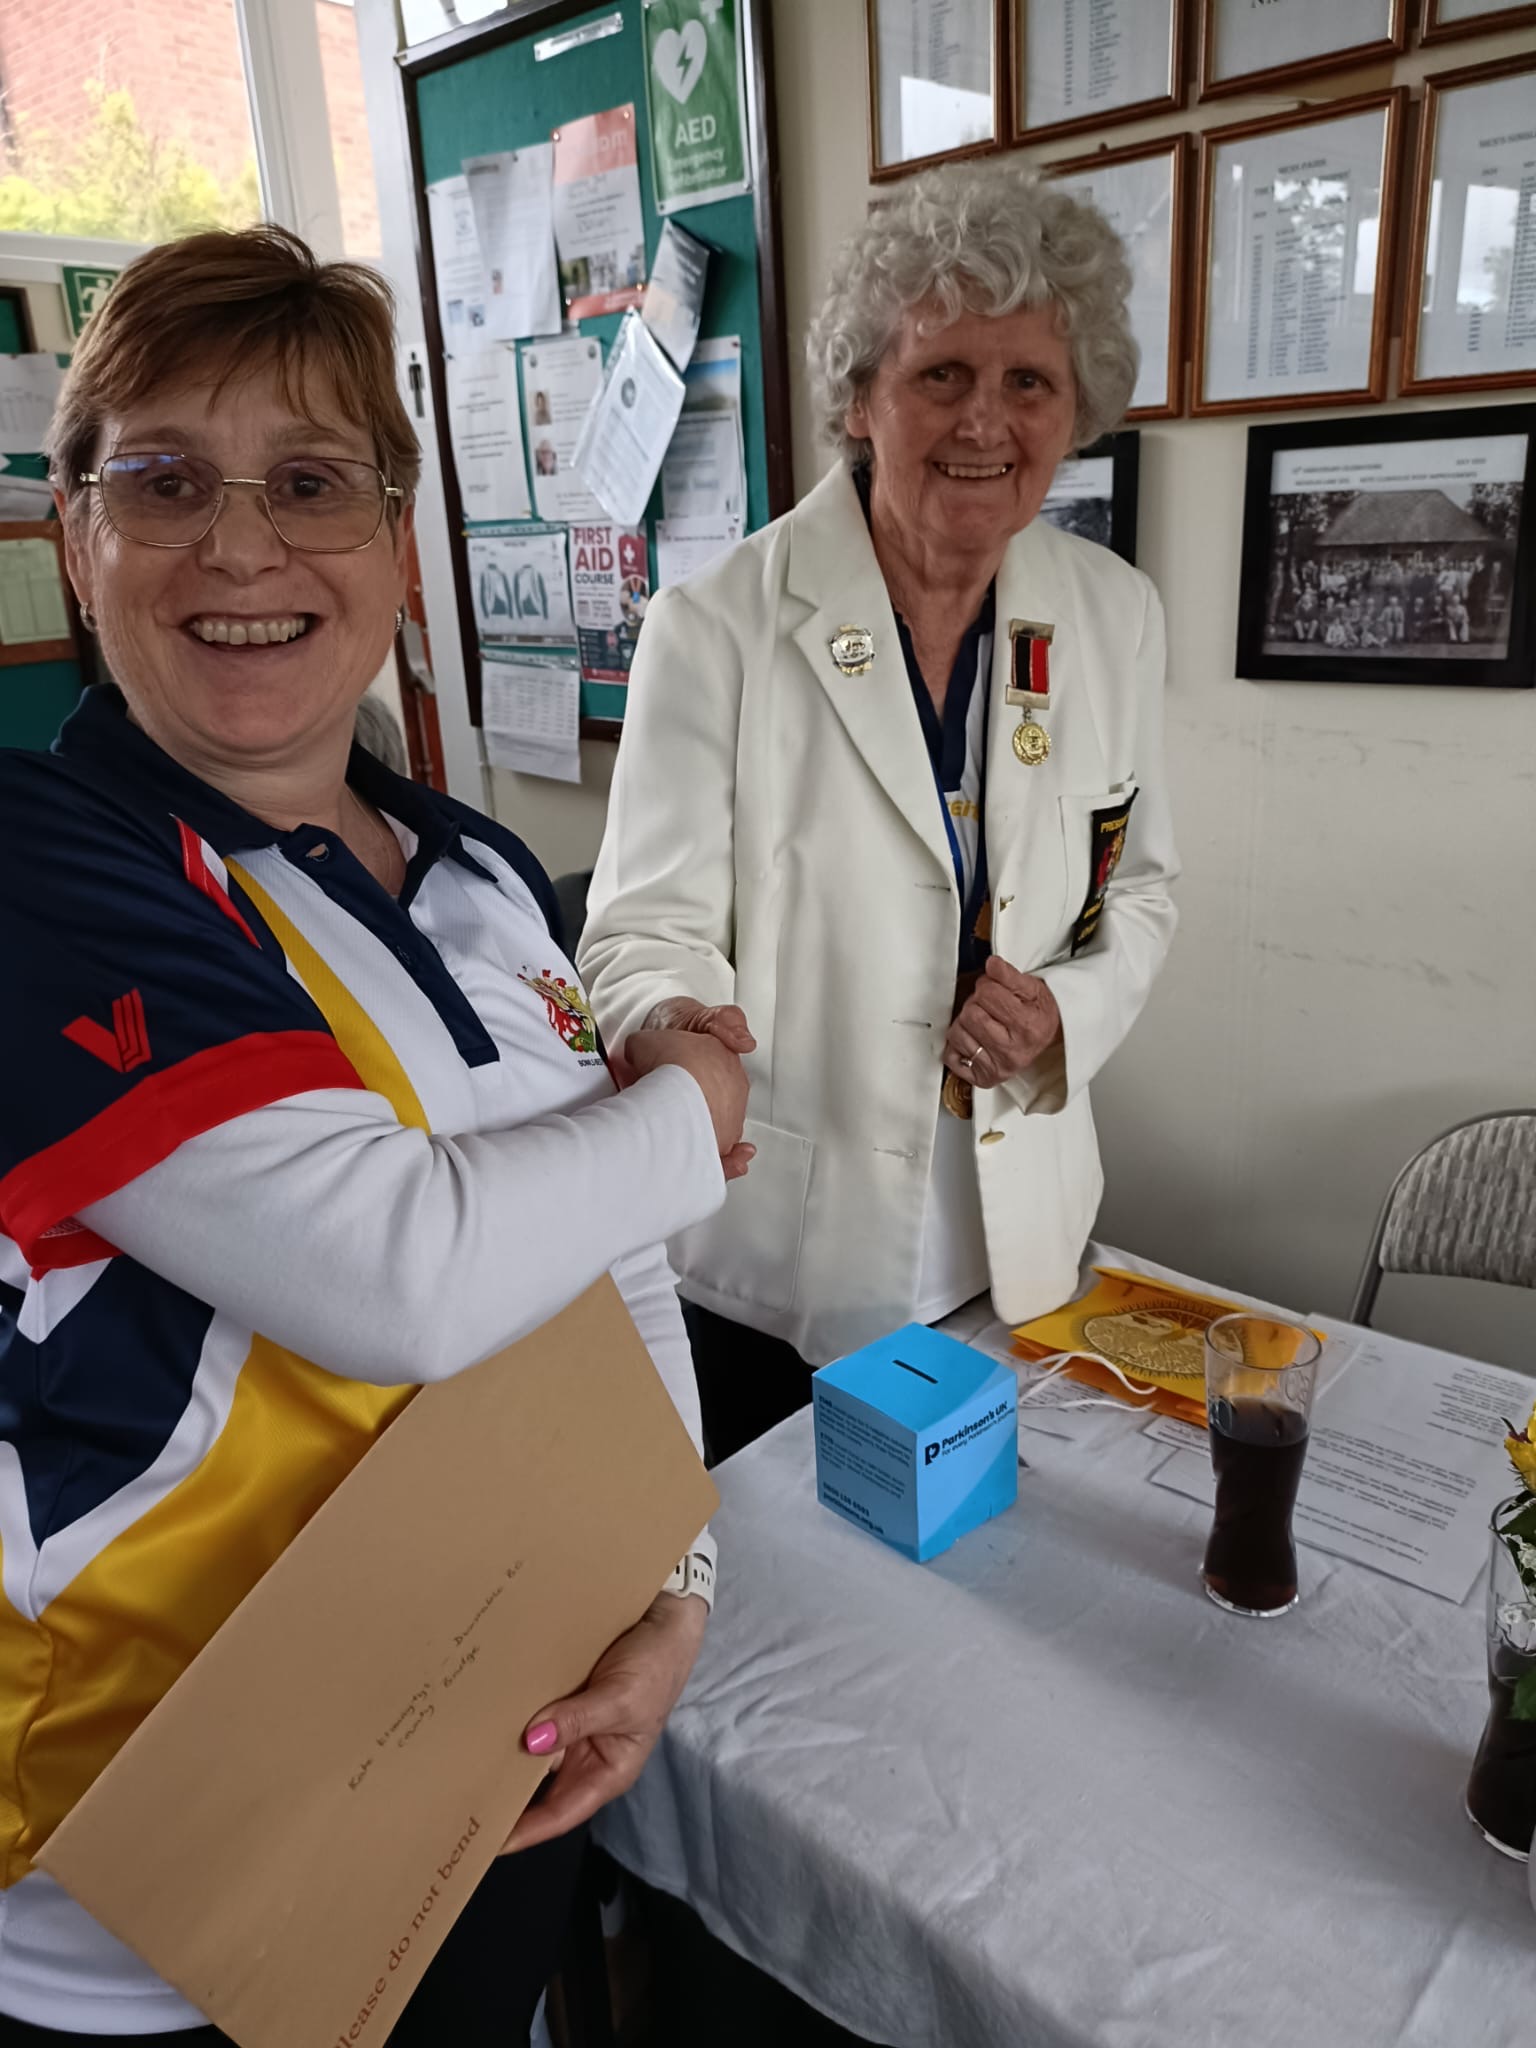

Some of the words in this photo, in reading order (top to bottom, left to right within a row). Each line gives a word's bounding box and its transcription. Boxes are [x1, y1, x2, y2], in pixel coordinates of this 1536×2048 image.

[675, 114, 717, 149] AED
[573, 527, 611, 545] FIRST
[575, 547, 614, 571] AID
[575, 573, 615, 585] COURSE
[941, 1409, 995, 1449] Parkinson's
[995, 1400, 1008, 1417] UK
[333, 1976, 387, 2048] lease
[388, 1936, 411, 1972] do
[411, 1885, 441, 1932] not
[437, 1815, 481, 1881] bend
